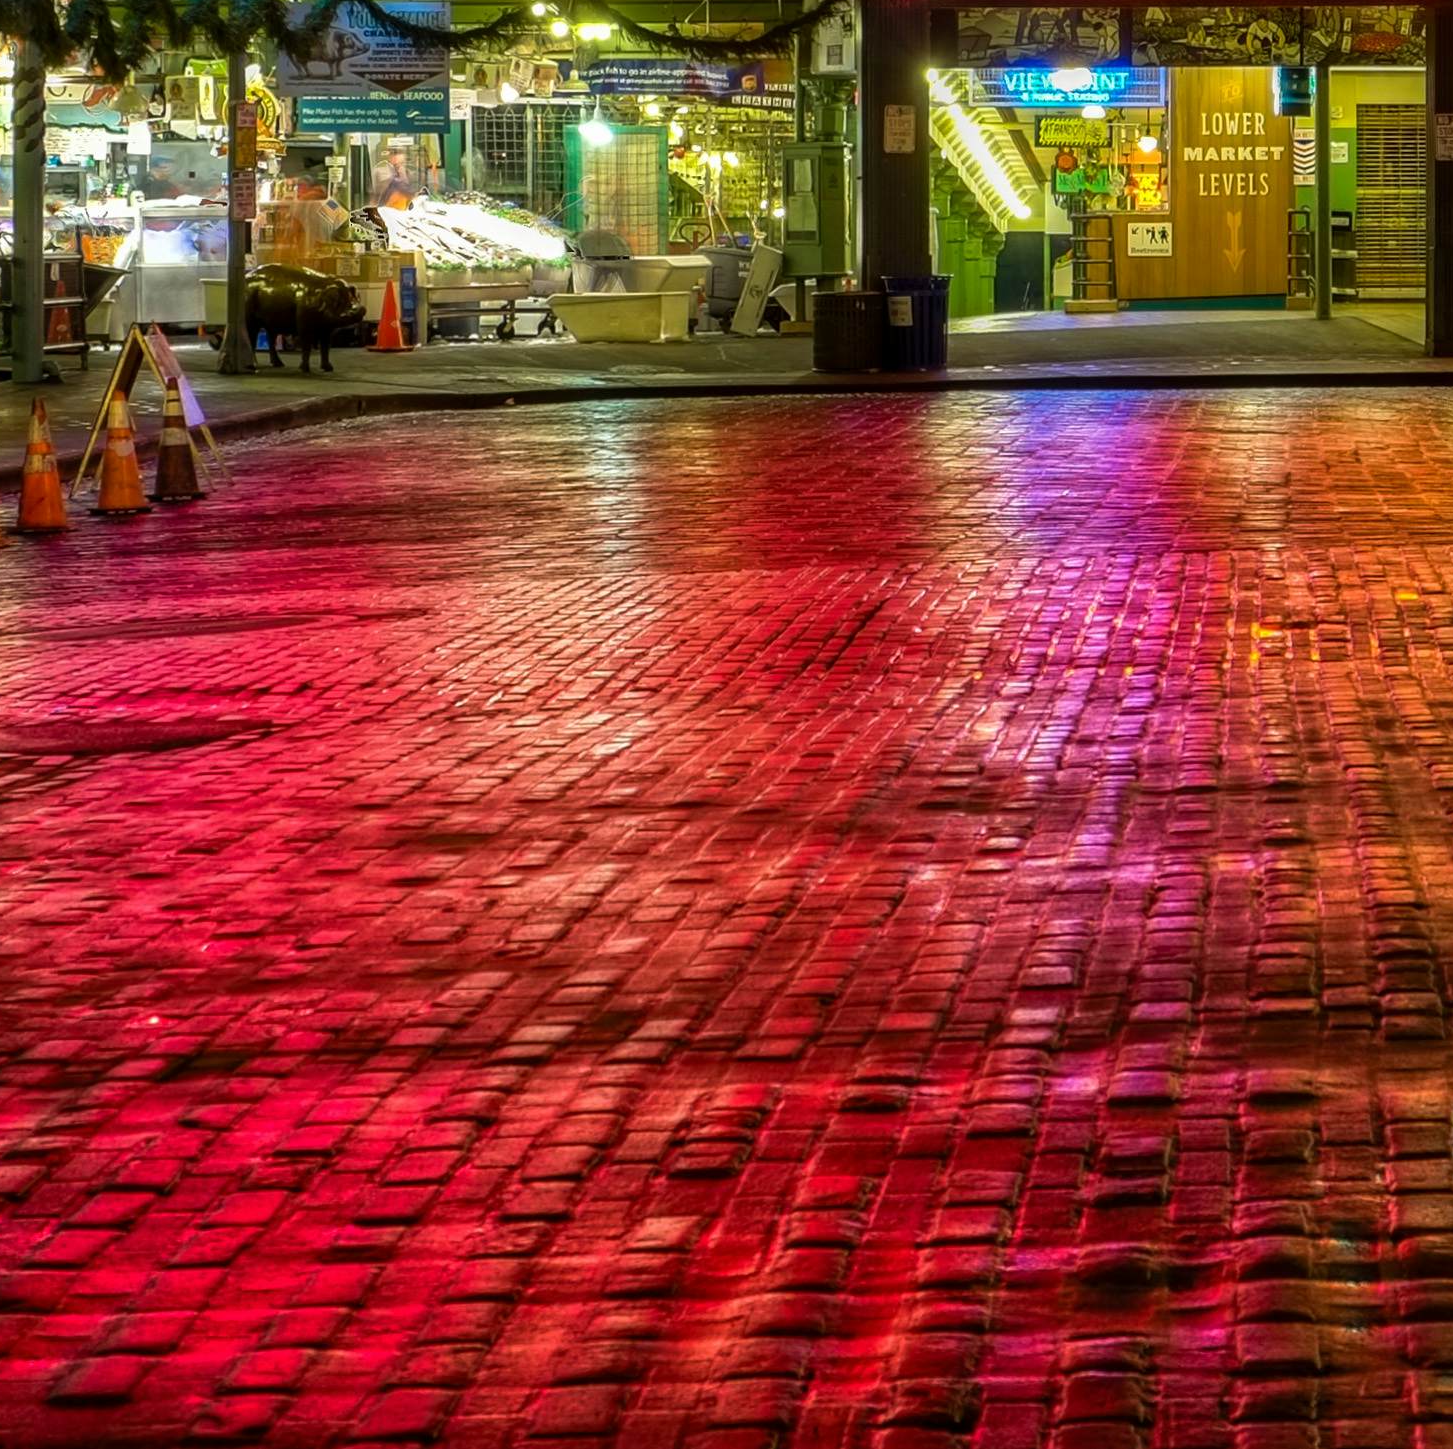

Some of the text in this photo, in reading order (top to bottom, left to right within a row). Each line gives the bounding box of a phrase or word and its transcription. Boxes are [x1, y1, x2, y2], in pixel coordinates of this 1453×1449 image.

[364, 73, 401, 81] DONATE
[1004, 71, 1129, 91] VIEWINT
[403, 91, 444, 101] SEAFOOD
[1201, 112, 1265, 136] LOWER
[1183, 146, 1284, 161] MARKET
[1199, 173, 1269, 196] LEVELS
